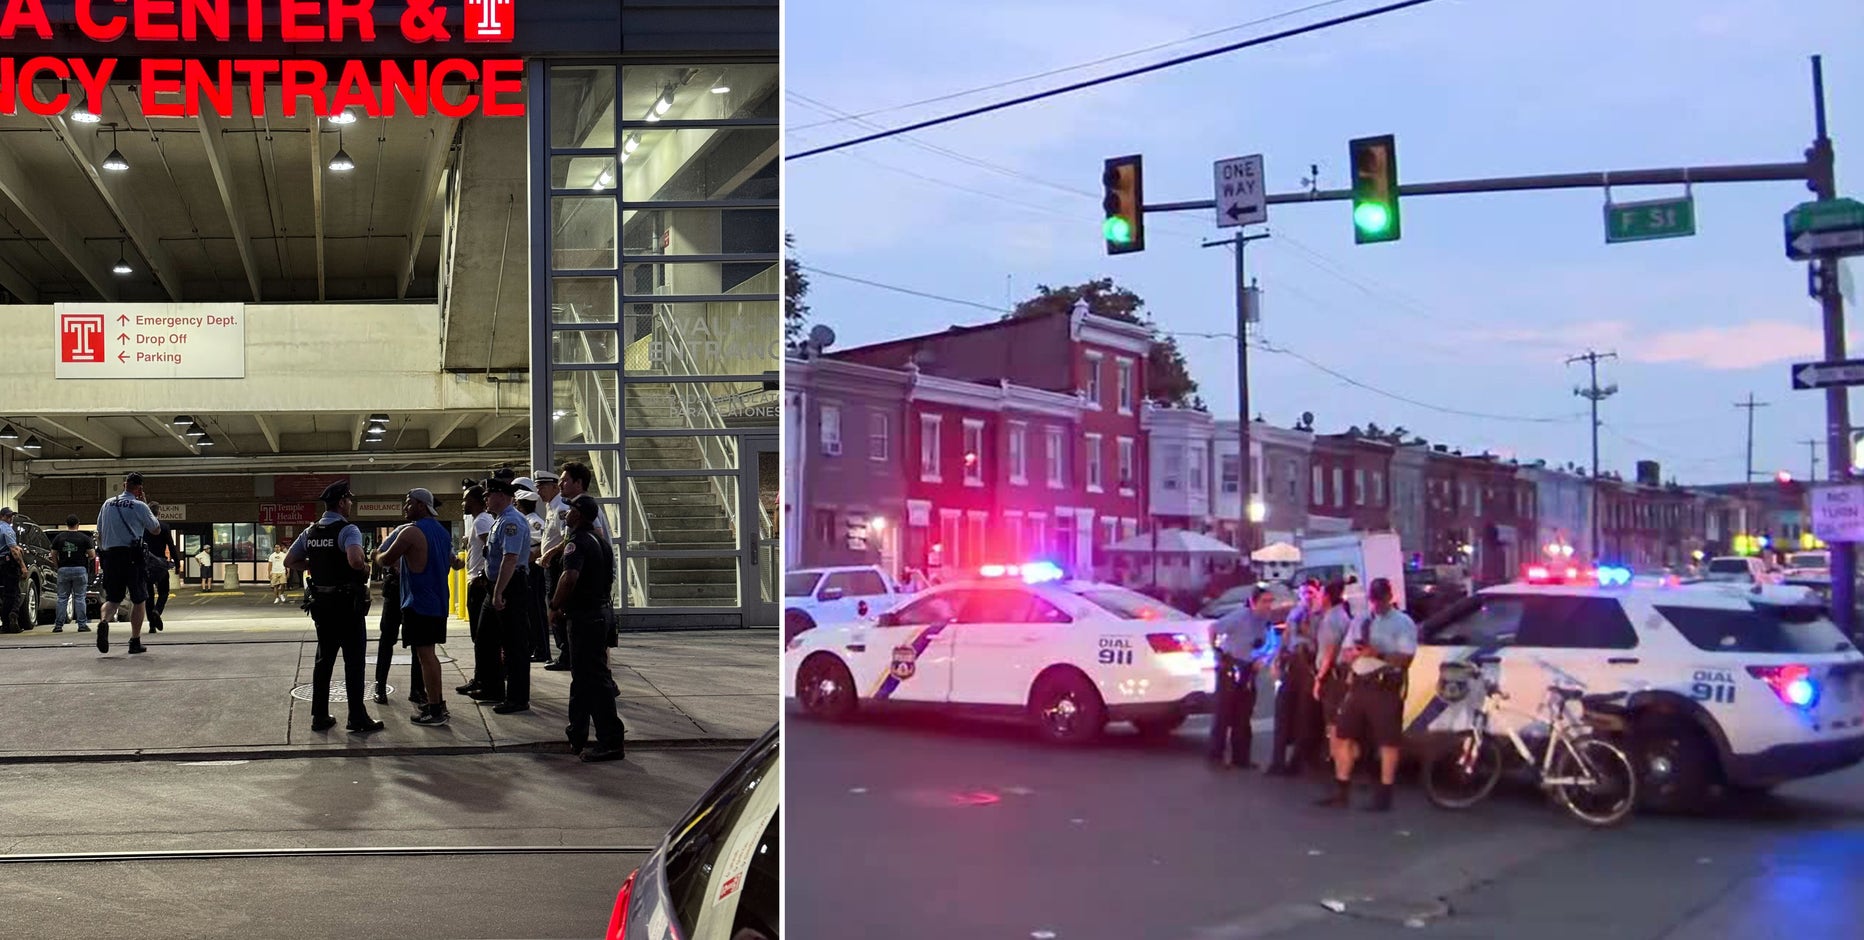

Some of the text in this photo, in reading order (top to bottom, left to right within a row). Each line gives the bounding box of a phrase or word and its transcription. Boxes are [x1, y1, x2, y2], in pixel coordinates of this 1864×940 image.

[75, 0, 376, 42] CENTER
[401, 0, 451, 43] &
[0, 56, 525, 118] CY ENTRANCE
[1223, 161, 1255, 180] ONE
[1223, 180, 1255, 198] WAY
[1621, 211, 1636, 231] F
[136, 315, 238, 328] Emergency Dept.
[136, 333, 188, 346] Drop Off
[136, 352, 182, 364] Parking
[277, 503, 305, 513] Temple
[277, 511, 303, 521] Health
[306, 538, 334, 548] POLICE
[1099, 638, 1133, 648] DIAL
[1098, 649, 1133, 665] 911
[1693, 671, 1735, 683] DIAL
[1691, 683, 1735, 703] 911
